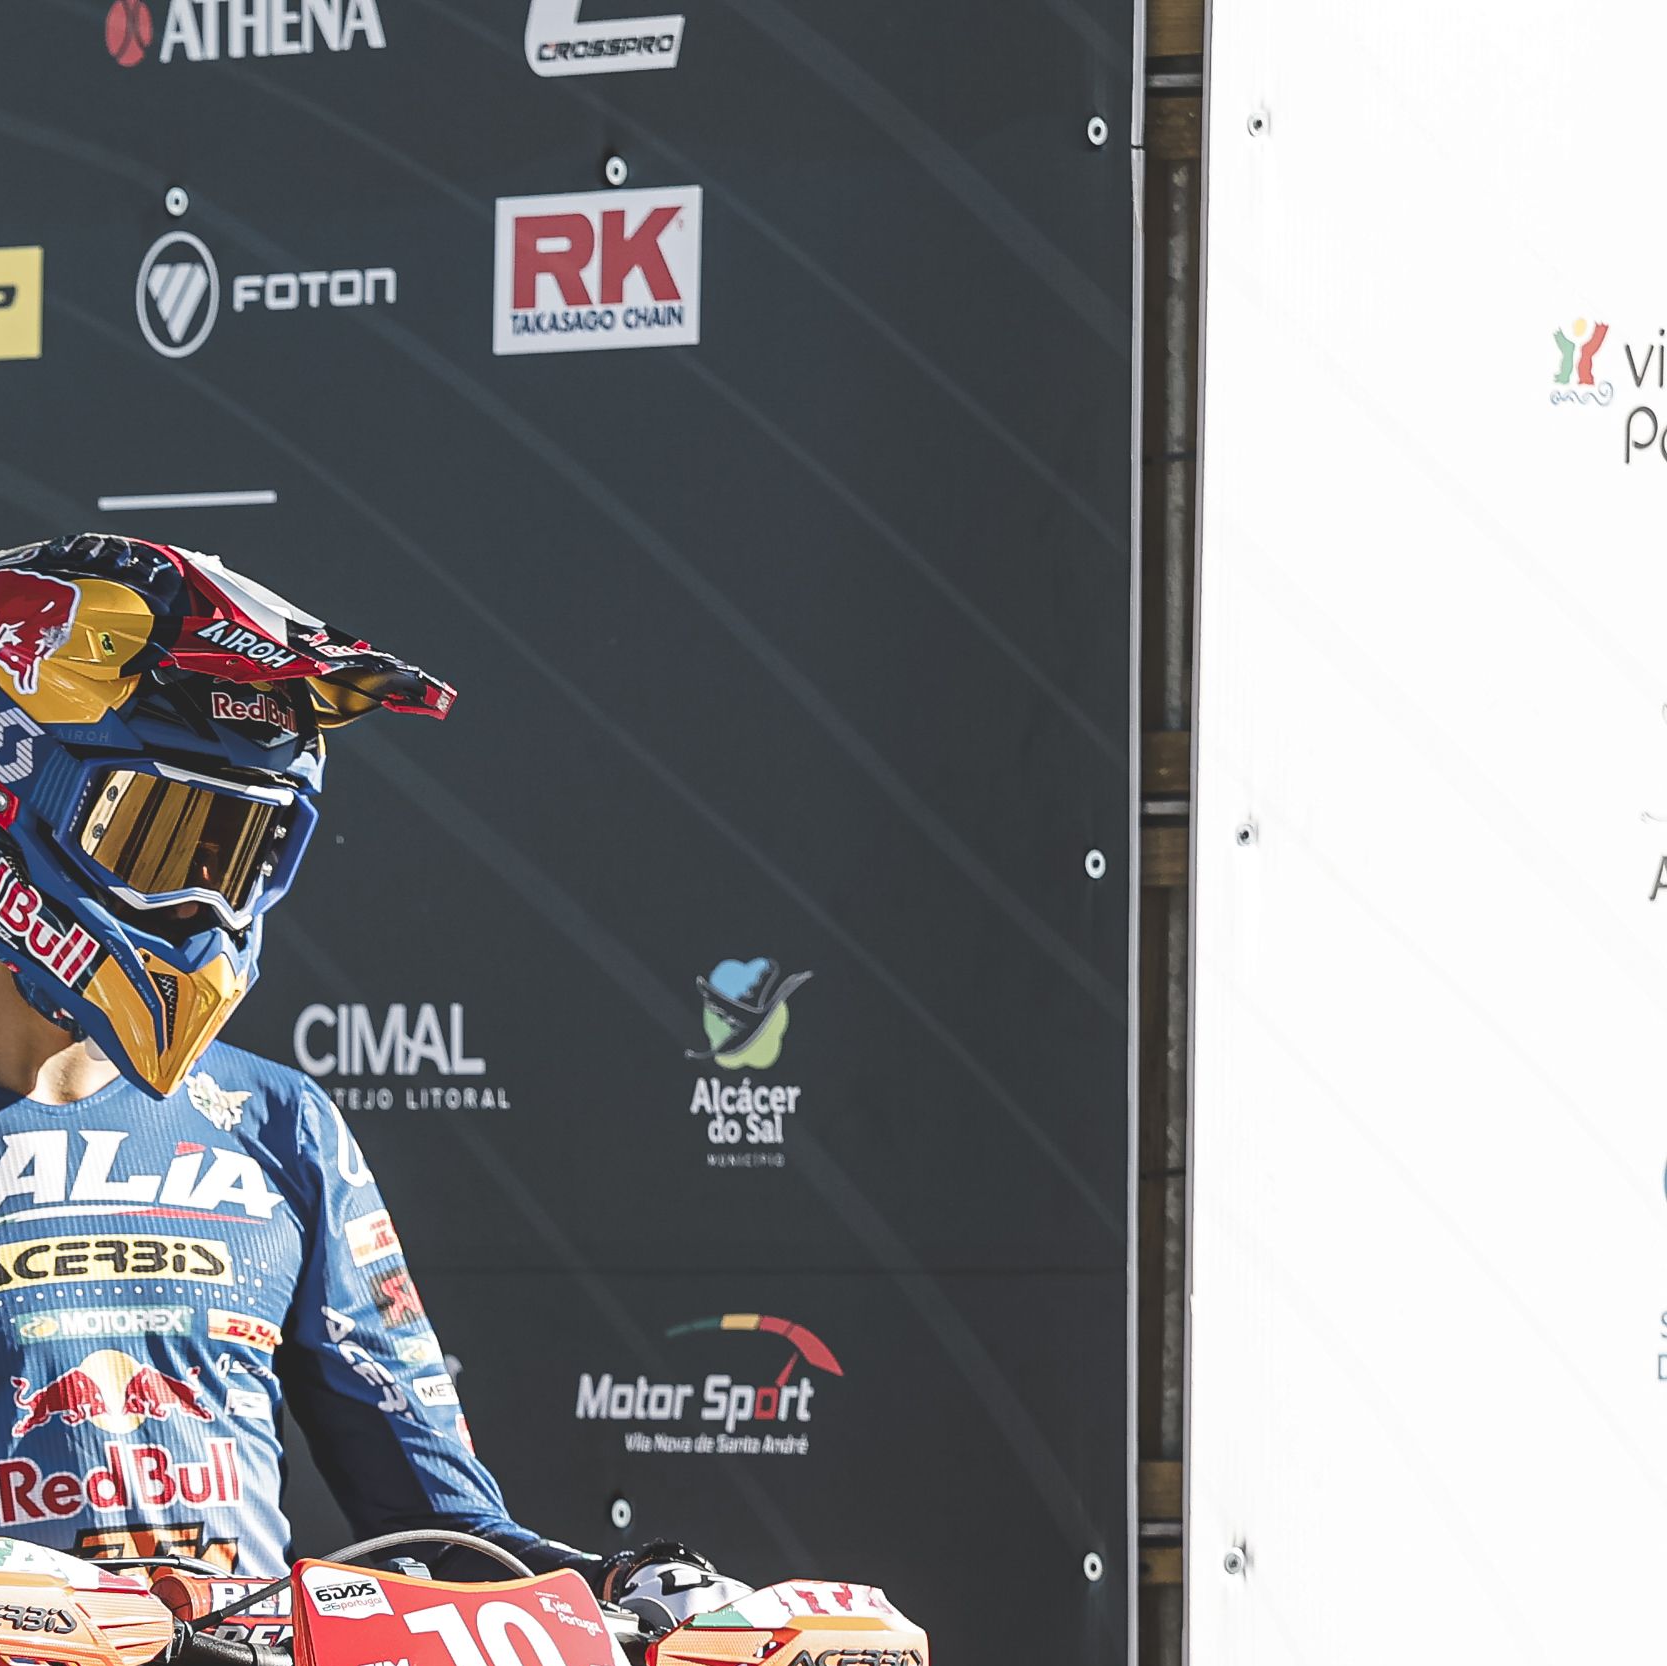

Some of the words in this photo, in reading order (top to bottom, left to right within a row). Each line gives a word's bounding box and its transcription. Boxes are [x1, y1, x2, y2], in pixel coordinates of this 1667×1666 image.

[159, 0, 387, 63] ATHENA
[537, 34, 675, 62] CROSSPRO
[512, 206, 683, 309] RK
[512, 310, 615, 337] TAKASAGO
[624, 306, 684, 331] CHAIN
[197, 620, 298, 670] AIROH
[293, 1002, 487, 1076] CIMAL
[405, 1088, 511, 1110] LITORAL
[689, 1077, 801, 1115] Alcácer
[707, 1116, 740, 1144] do
[745, 1115, 785, 1145] Sal
[62, 1306, 188, 1336] MOTOREX
[575, 1373, 694, 1420] Motor
[701, 1374, 815, 1433] Sport
[316, 1583, 377, 1602] 6DAYS
